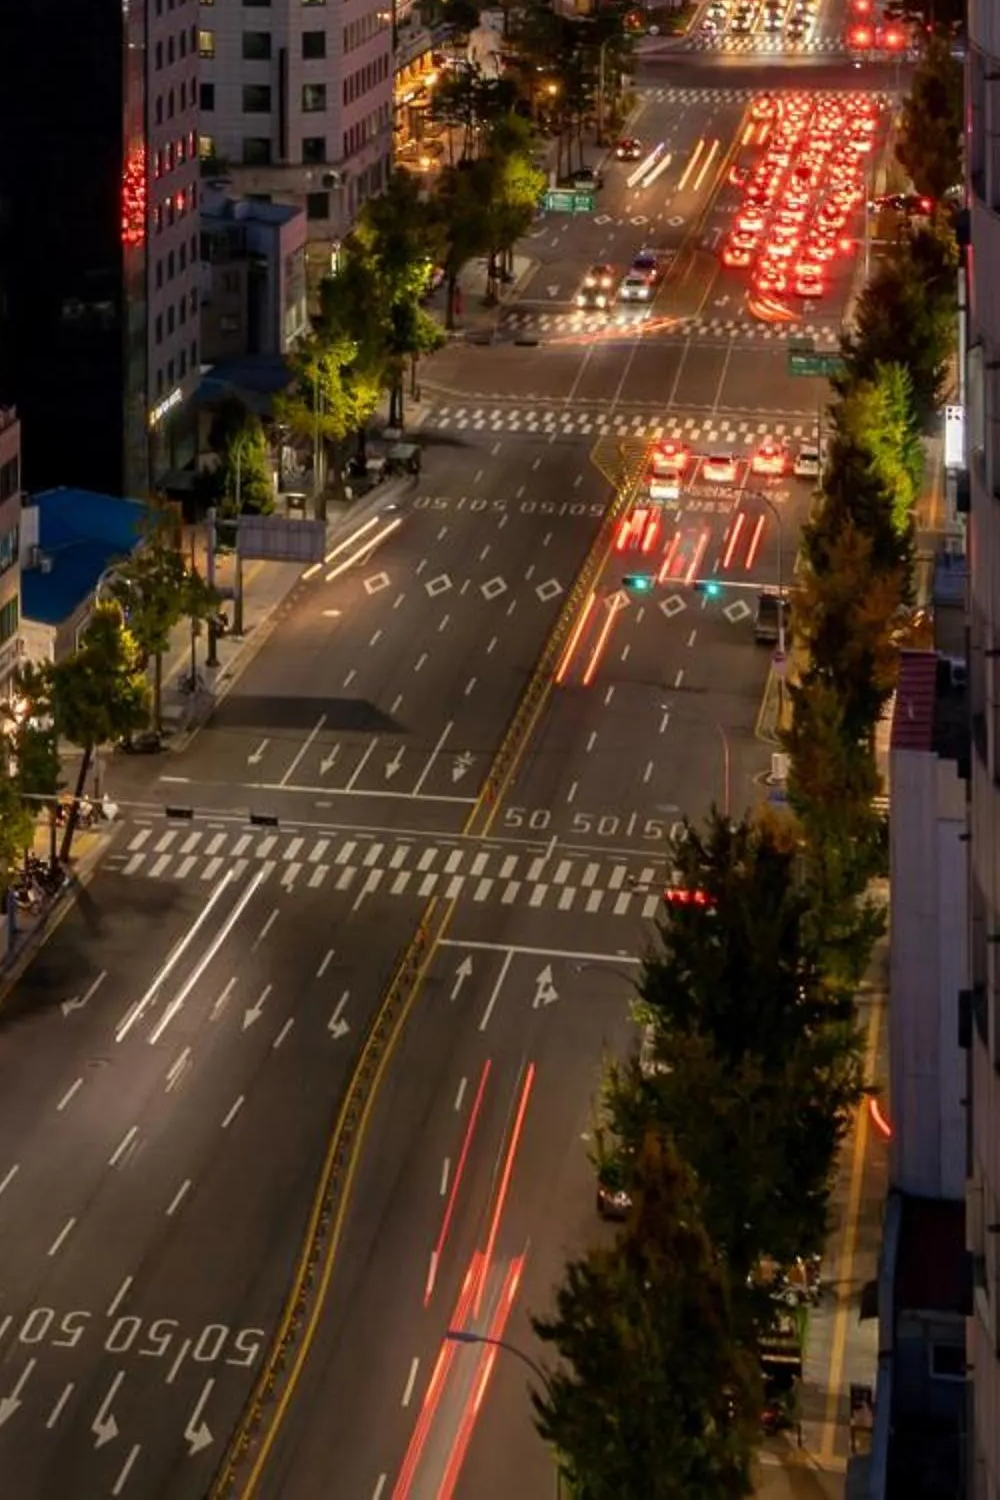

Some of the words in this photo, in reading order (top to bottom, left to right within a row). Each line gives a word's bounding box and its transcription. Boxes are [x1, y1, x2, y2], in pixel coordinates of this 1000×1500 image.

[502, 806, 552, 830] 50
[569, 812, 620, 836] 50
[641, 819, 690, 843] 50
[18, 1306, 92, 1348] 50
[103, 1314, 181, 1357] 50
[192, 1323, 266, 1367] 50
